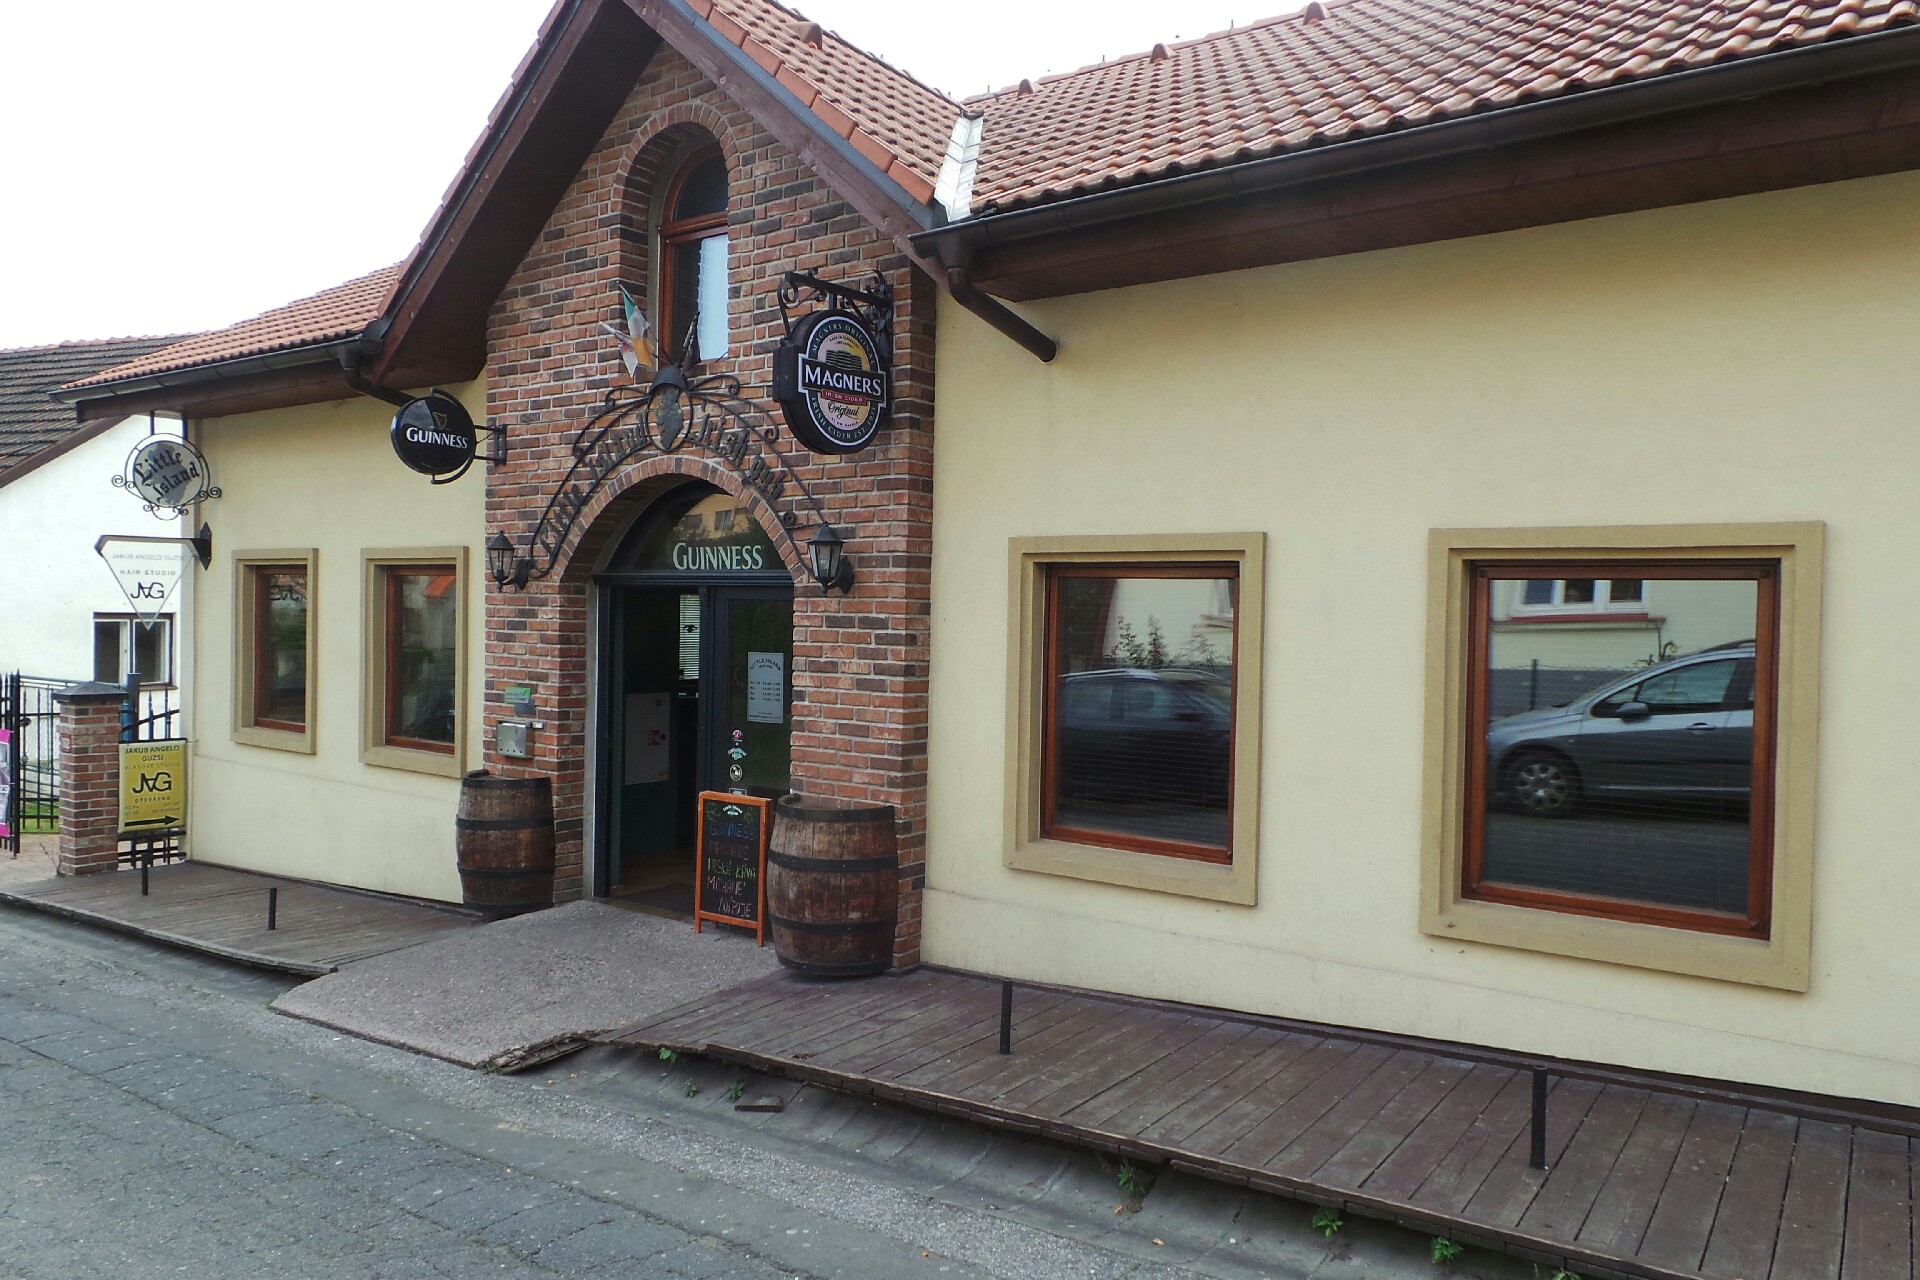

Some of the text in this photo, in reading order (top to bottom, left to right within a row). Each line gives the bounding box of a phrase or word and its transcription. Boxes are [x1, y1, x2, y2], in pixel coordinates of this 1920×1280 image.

[812, 323, 842, 352] MAGNERS
[805, 363, 882, 397] MAGNERS
[825, 391, 863, 403] IRISH CIDER
[827, 400, 861, 419] Original
[811, 397, 826, 426] IRISH
[828, 426, 851, 439] CIDER
[405, 427, 468, 449] GUINNESS
[134, 449, 183, 486] Little
[145, 461, 200, 503] Island
[672, 542, 763, 571] GUINNESS
[141, 754, 164, 762] GUZSI
